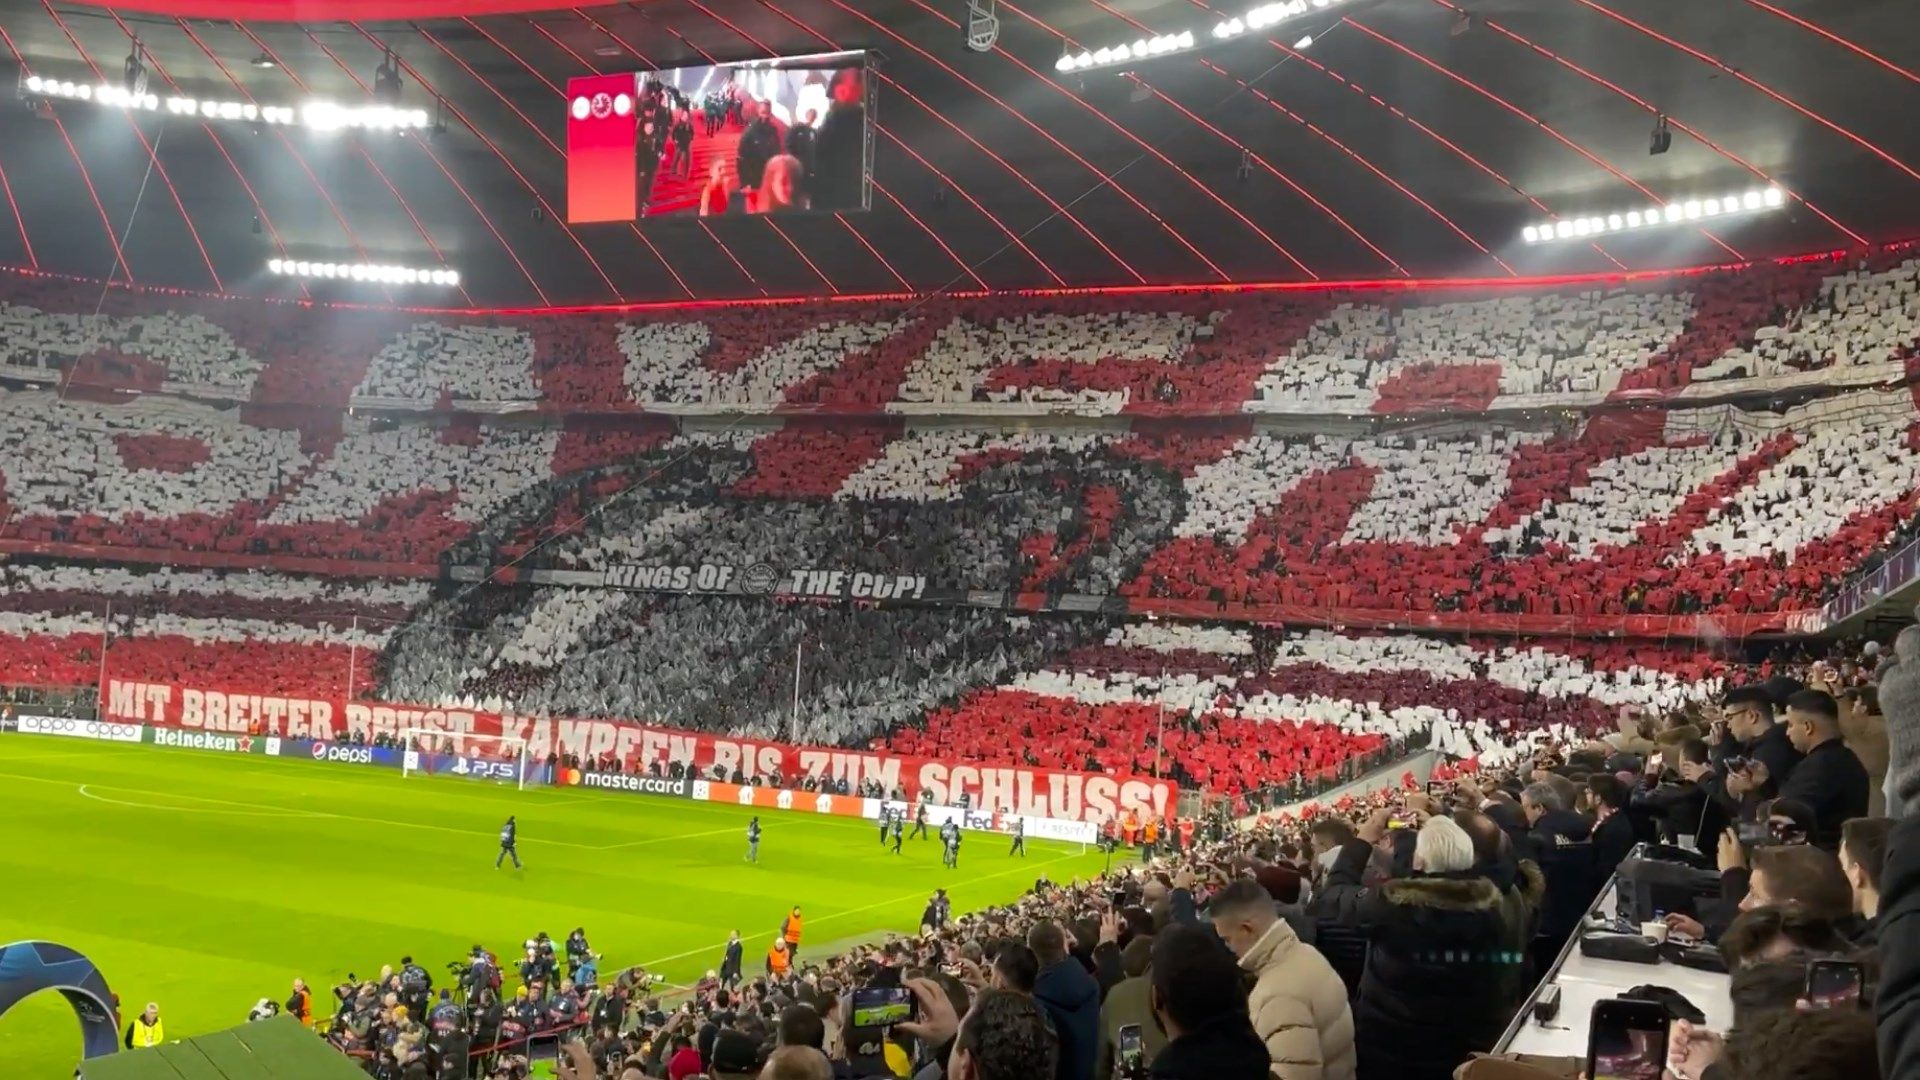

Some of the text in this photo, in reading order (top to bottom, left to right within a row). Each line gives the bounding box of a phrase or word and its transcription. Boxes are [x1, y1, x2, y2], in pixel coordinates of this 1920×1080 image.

[604, 563, 689, 589] KINGS
[699, 564, 733, 591] OF
[789, 569, 843, 597] THE
[850, 572, 926, 600] CUP!
[154, 727, 236, 752] Heineken
[109, 680, 171, 722] MIT
[182, 689, 333, 741] BREITER
[917, 762, 1169, 829] SCHLUSS!
[328, 746, 371, 763] pepsi
[472, 760, 514, 778] PS5
[584, 772, 684, 796] mastercard
